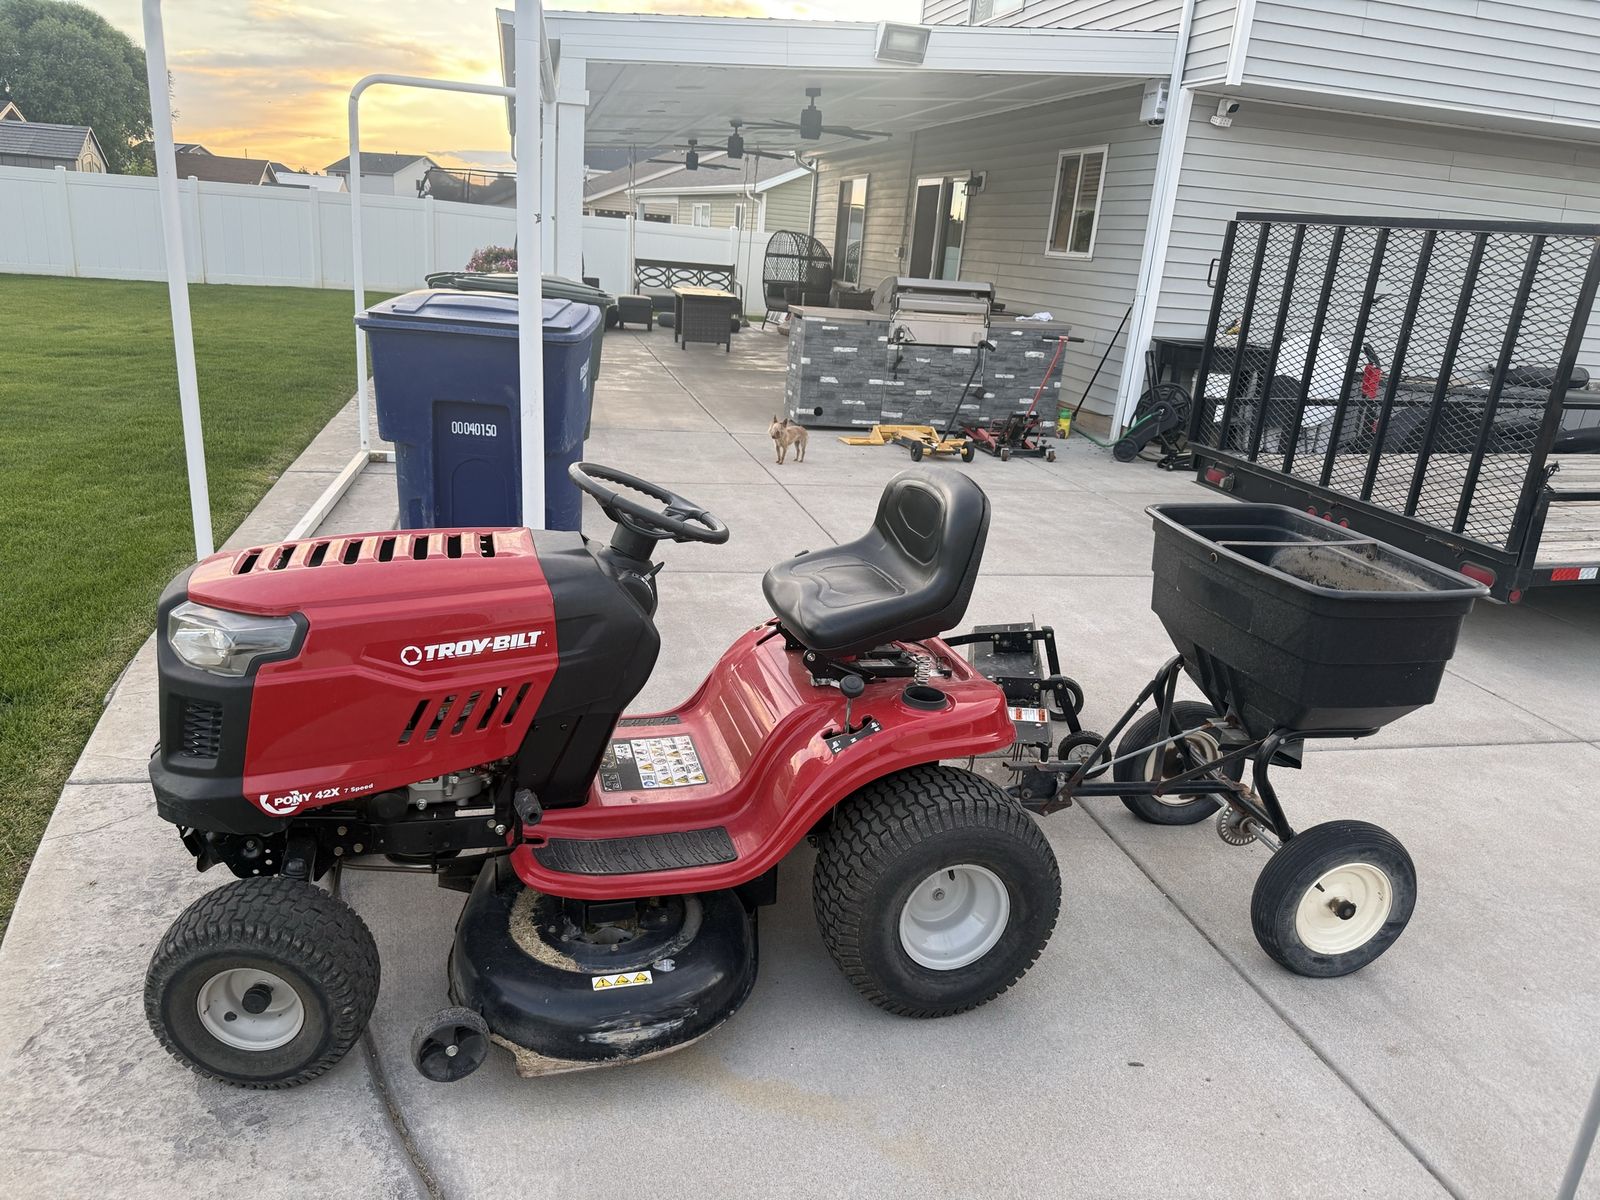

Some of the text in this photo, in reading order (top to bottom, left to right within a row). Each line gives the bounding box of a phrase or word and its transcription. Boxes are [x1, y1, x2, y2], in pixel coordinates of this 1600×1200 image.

[451, 421, 497, 437] 00040150
[424, 631, 542, 662] TROY-BILT
[274, 792, 312, 806] PONY
[315, 787, 341, 799] 42X
[351, 783, 374, 793] Speed
